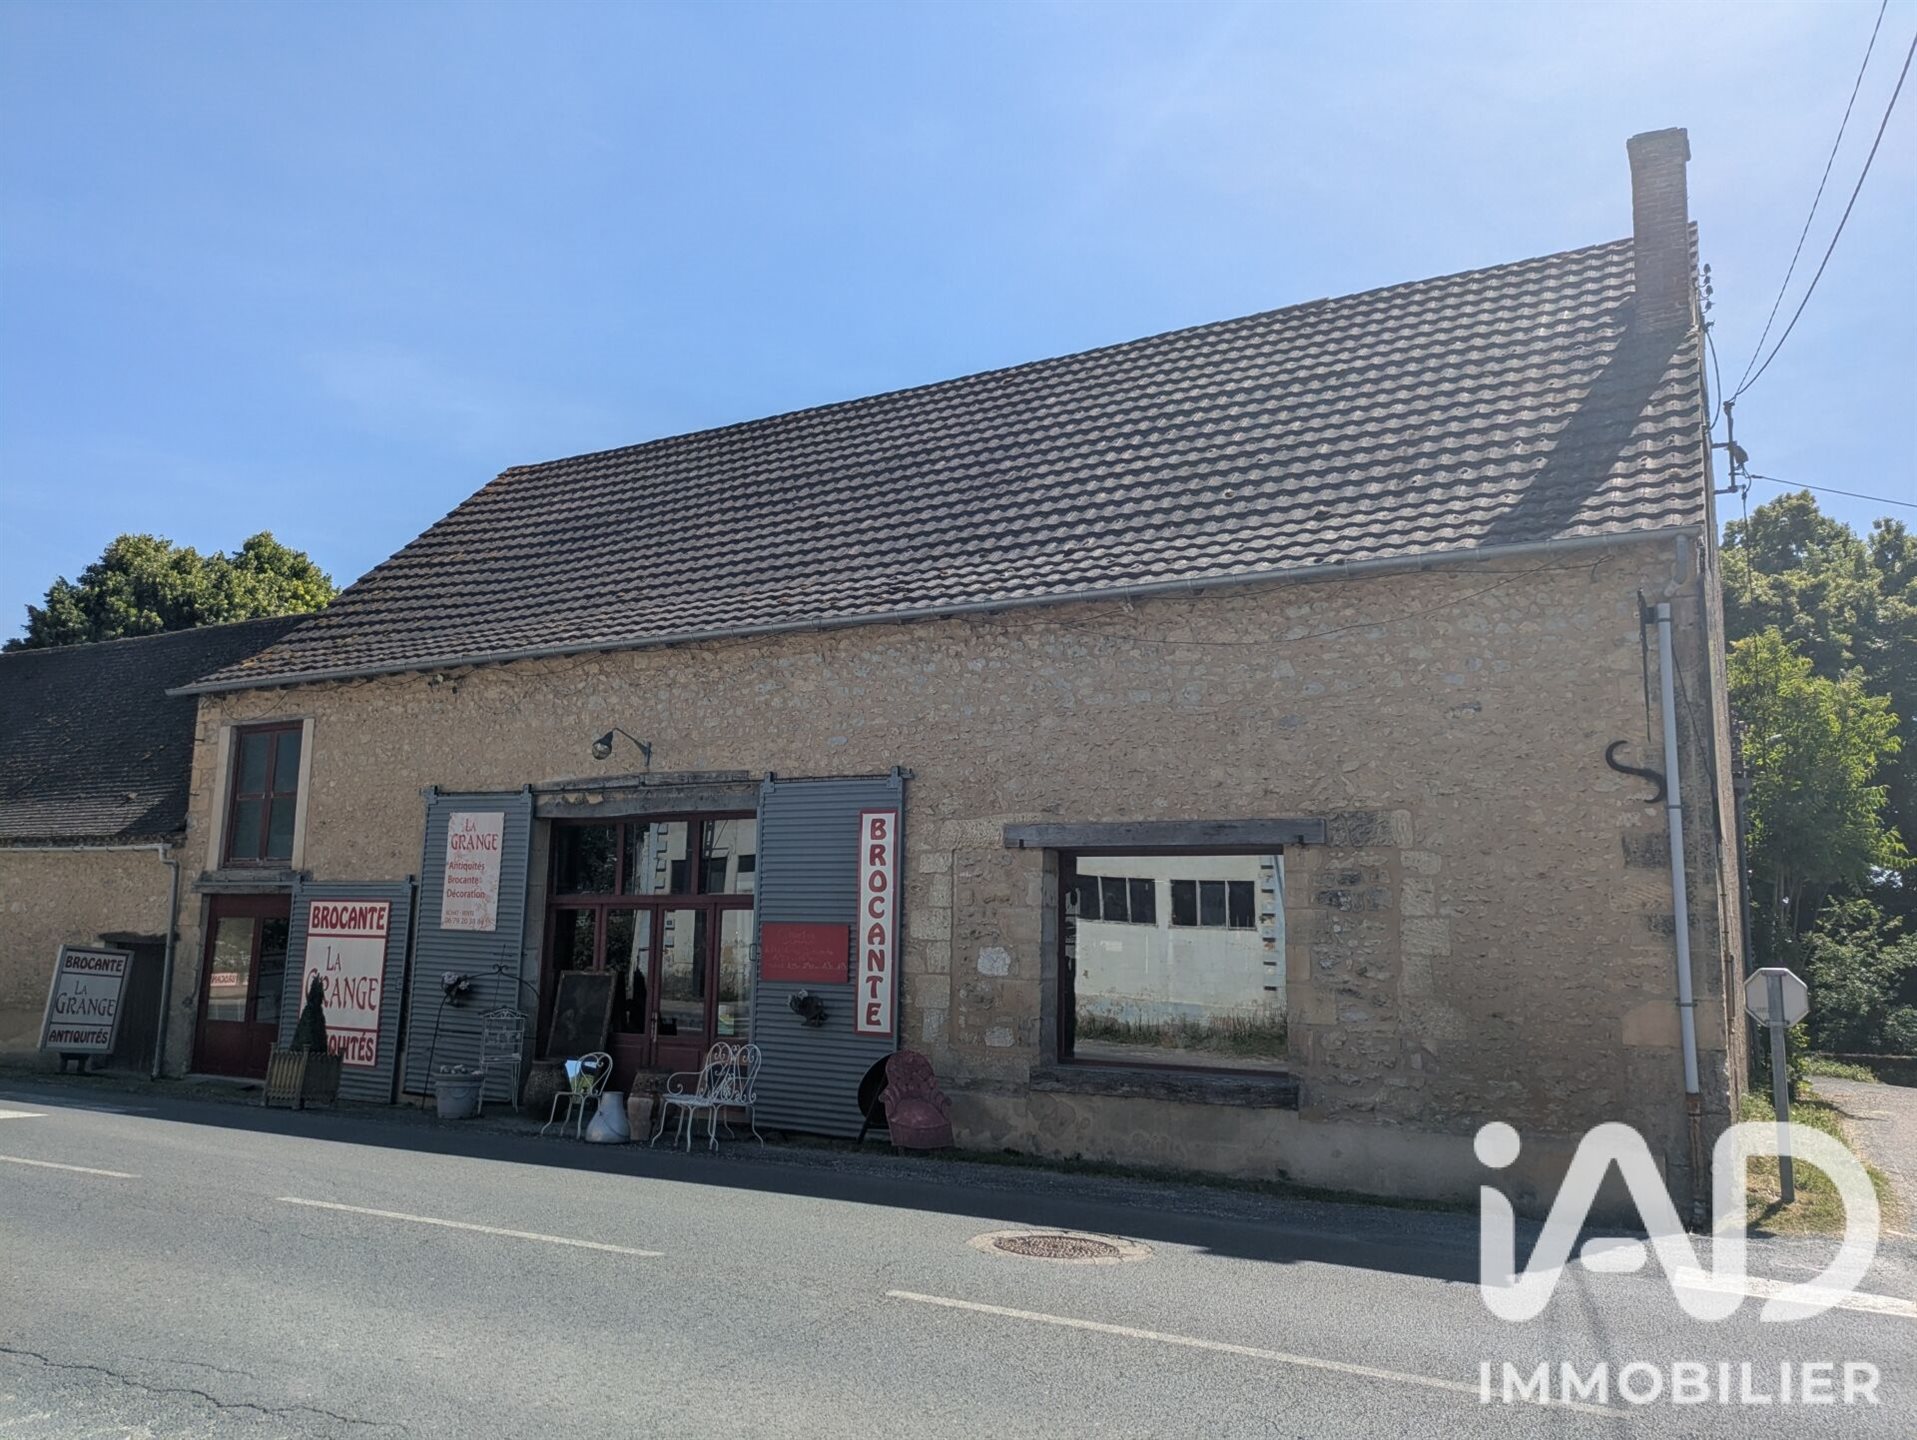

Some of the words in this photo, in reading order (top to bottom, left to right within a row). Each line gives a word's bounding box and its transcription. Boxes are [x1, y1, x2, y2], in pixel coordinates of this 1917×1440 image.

[465, 818, 476, 832] LA
[451, 833, 498, 850] GRANGE
[448, 861, 485, 872] Antiquités
[447, 875, 479, 885] Brocante
[447, 888, 485, 899] Décoration
[311, 905, 386, 930] BROCANTE
[866, 818, 887, 1026] BROCANTE
[65, 955, 124, 972] BROCANTE
[326, 945, 341, 972] LA
[75, 980, 87, 995] LA
[55, 992, 117, 1017] GRANGE
[48, 1028, 109, 1044] ANTIQUITÉS
